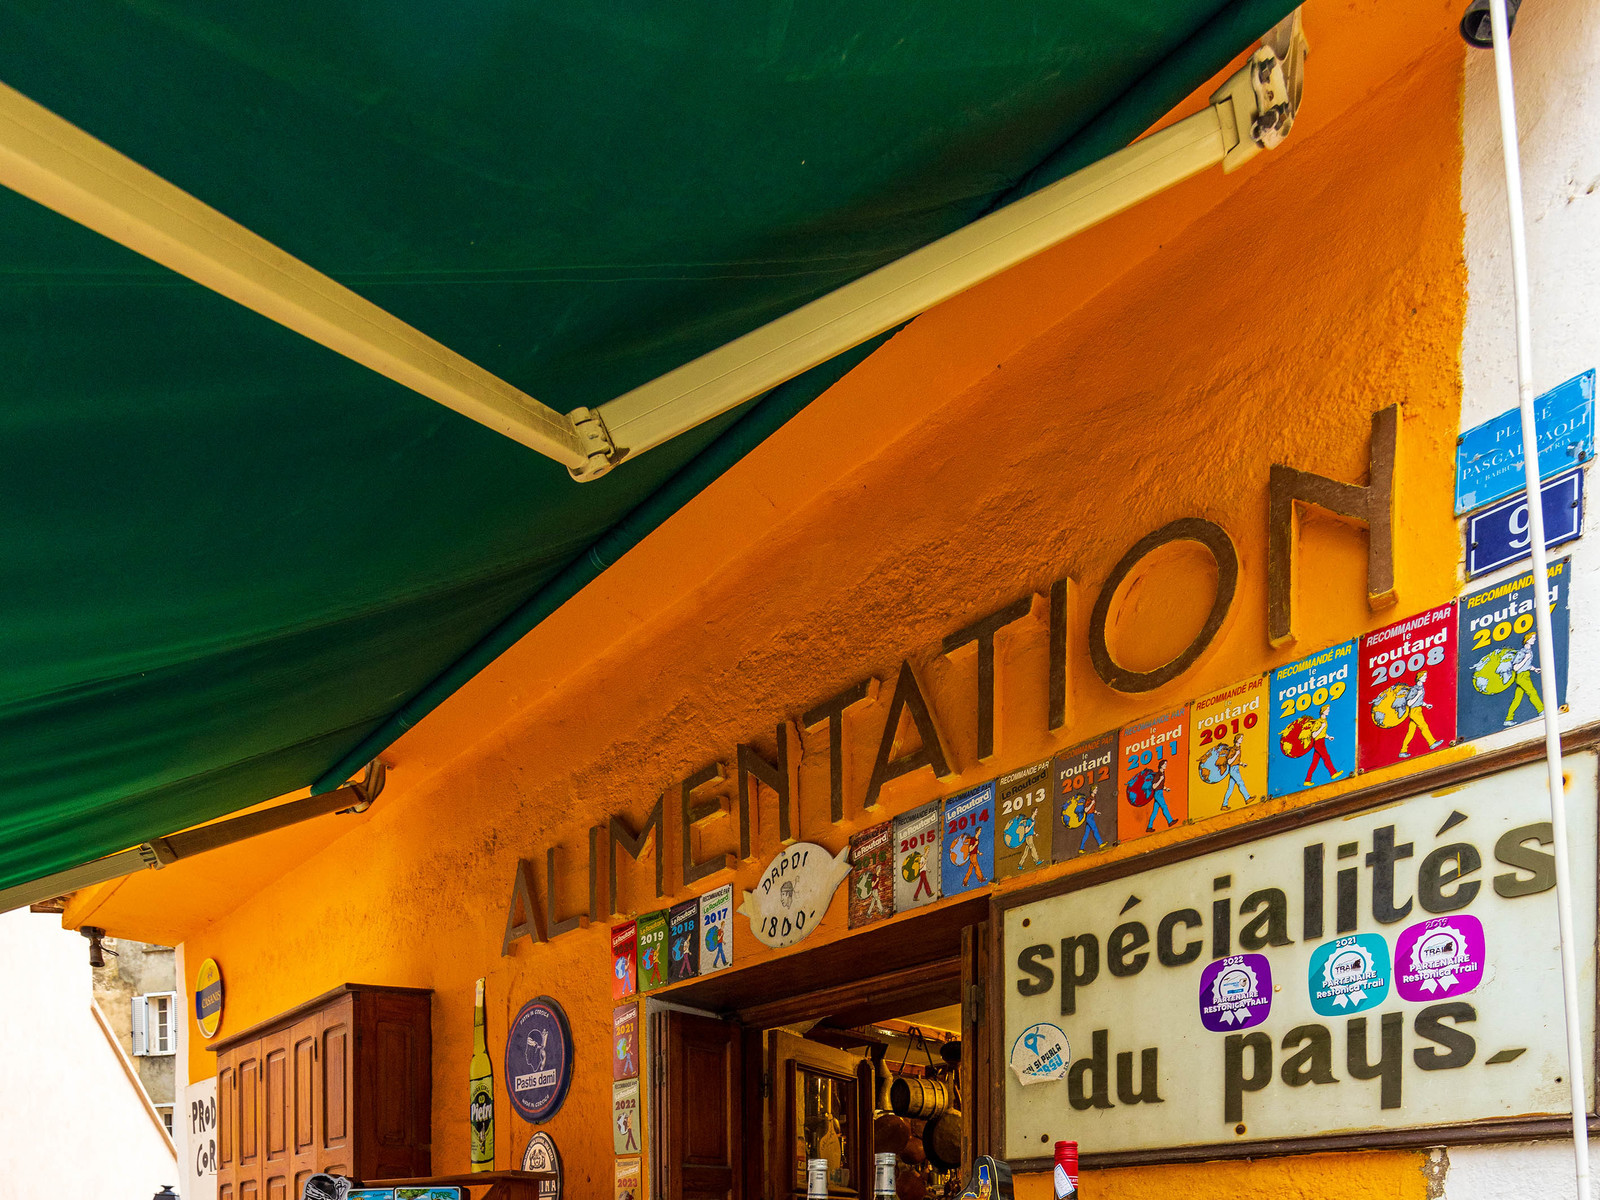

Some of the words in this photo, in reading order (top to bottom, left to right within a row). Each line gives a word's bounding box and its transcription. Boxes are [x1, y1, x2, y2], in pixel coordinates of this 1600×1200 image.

[1467, 574, 1535, 609] RECOMMAND
[1508, 592, 1519, 602] le
[1470, 585, 1558, 631] routad
[1366, 612, 1430, 647] RECOMMANDÉ
[1432, 607, 1451, 622] PAR
[1402, 632, 1411, 641] le
[1369, 627, 1447, 668] routard
[1277, 650, 1334, 680] RECOMMANDÉ
[1335, 645, 1352, 658] PAR
[1308, 667, 1317, 676] le
[1371, 646, 1445, 687] 2008
[502, 402, 1398, 956] ALIMENTATION
[1279, 664, 1348, 701] routard
[1196, 684, 1247, 711] RECOMMANDÉ
[1248, 678, 1263, 691] PAR
[1280, 682, 1346, 719] 2009
[1197, 696, 1260, 730] routard
[1125, 725, 1182, 755] routard
[1199, 713, 1258, 746] 2010
[1060, 751, 1111, 780] routard
[1127, 741, 1178, 771] 2011
[1061, 766, 1110, 794] 2012
[1002, 788, 1046, 815] 2013
[948, 809, 989, 834] 2014
[900, 830, 935, 853] 2015
[704, 908, 728, 926] 2017
[1017, 810, 1558, 1016] spécialités
[641, 931, 664, 946] 2019
[671, 920, 694, 936] 2018
[1336, 937, 1356, 948] 2021
[1223, 955, 1244, 966] 2022
[1403, 967, 1452, 984] Restonica
[1455, 962, 1478, 975] Trail
[1410, 954, 1470, 972] PARTENAIRE
[1316, 984, 1360, 999] Restonica
[1363, 978, 1384, 991] Trail
[1322, 971, 1377, 988] PARTENAIRE
[1204, 1000, 1246, 1014] RESTONICA
[1246, 997, 1268, 1008] TRAIL
[1213, 991, 1258, 1004] PARTENAIRE
[616, 1022, 634, 1036] 2021
[516, 1075, 537, 1089] Pastis
[538, 1071, 555, 1085] dami
[1068, 1028, 1165, 1111] du
[615, 1099, 636, 1111] 2022
[617, 1178, 638, 1188] 2023
